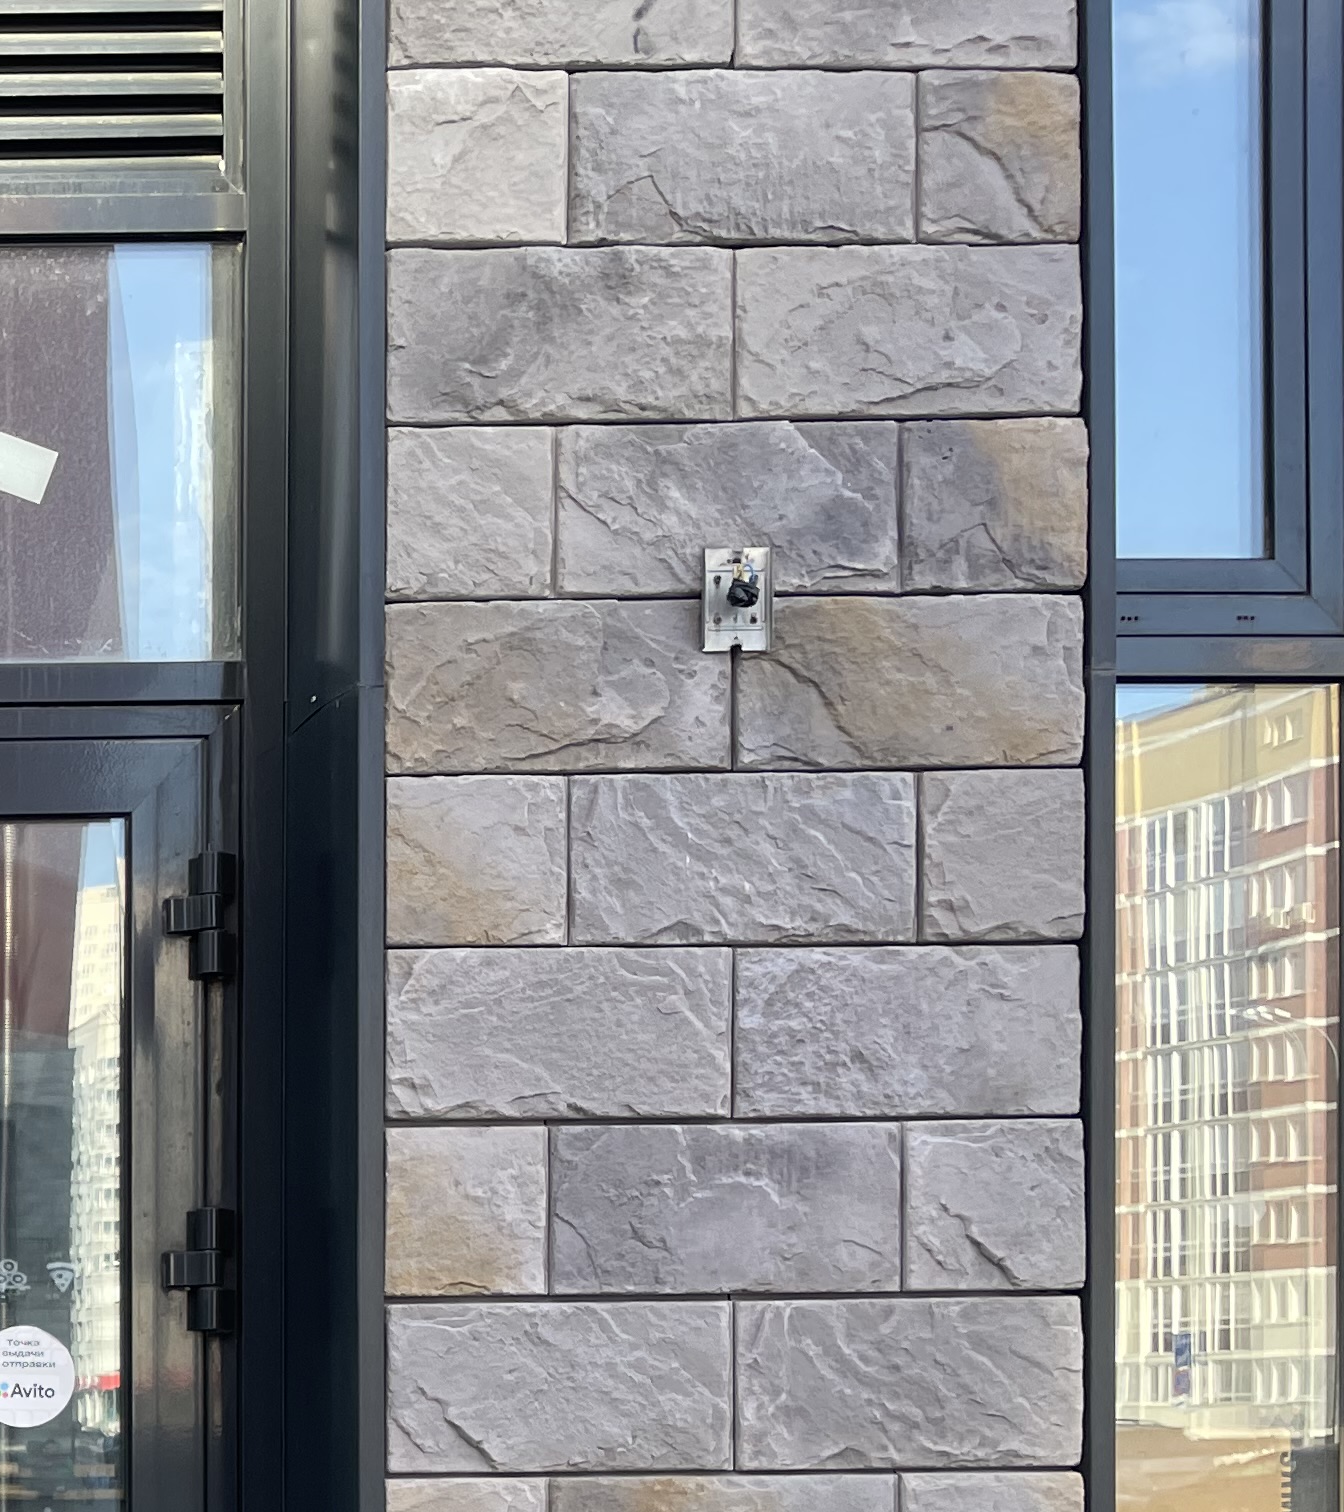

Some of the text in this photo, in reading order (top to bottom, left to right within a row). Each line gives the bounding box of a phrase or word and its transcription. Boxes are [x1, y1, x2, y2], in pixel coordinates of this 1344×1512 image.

[7, 1339, 40, 1347] Точка
[1, 1350, 45, 1358] выдачи
[1, 1361, 56, 1369] отправки
[10, 1383, 55, 1398] Avito
